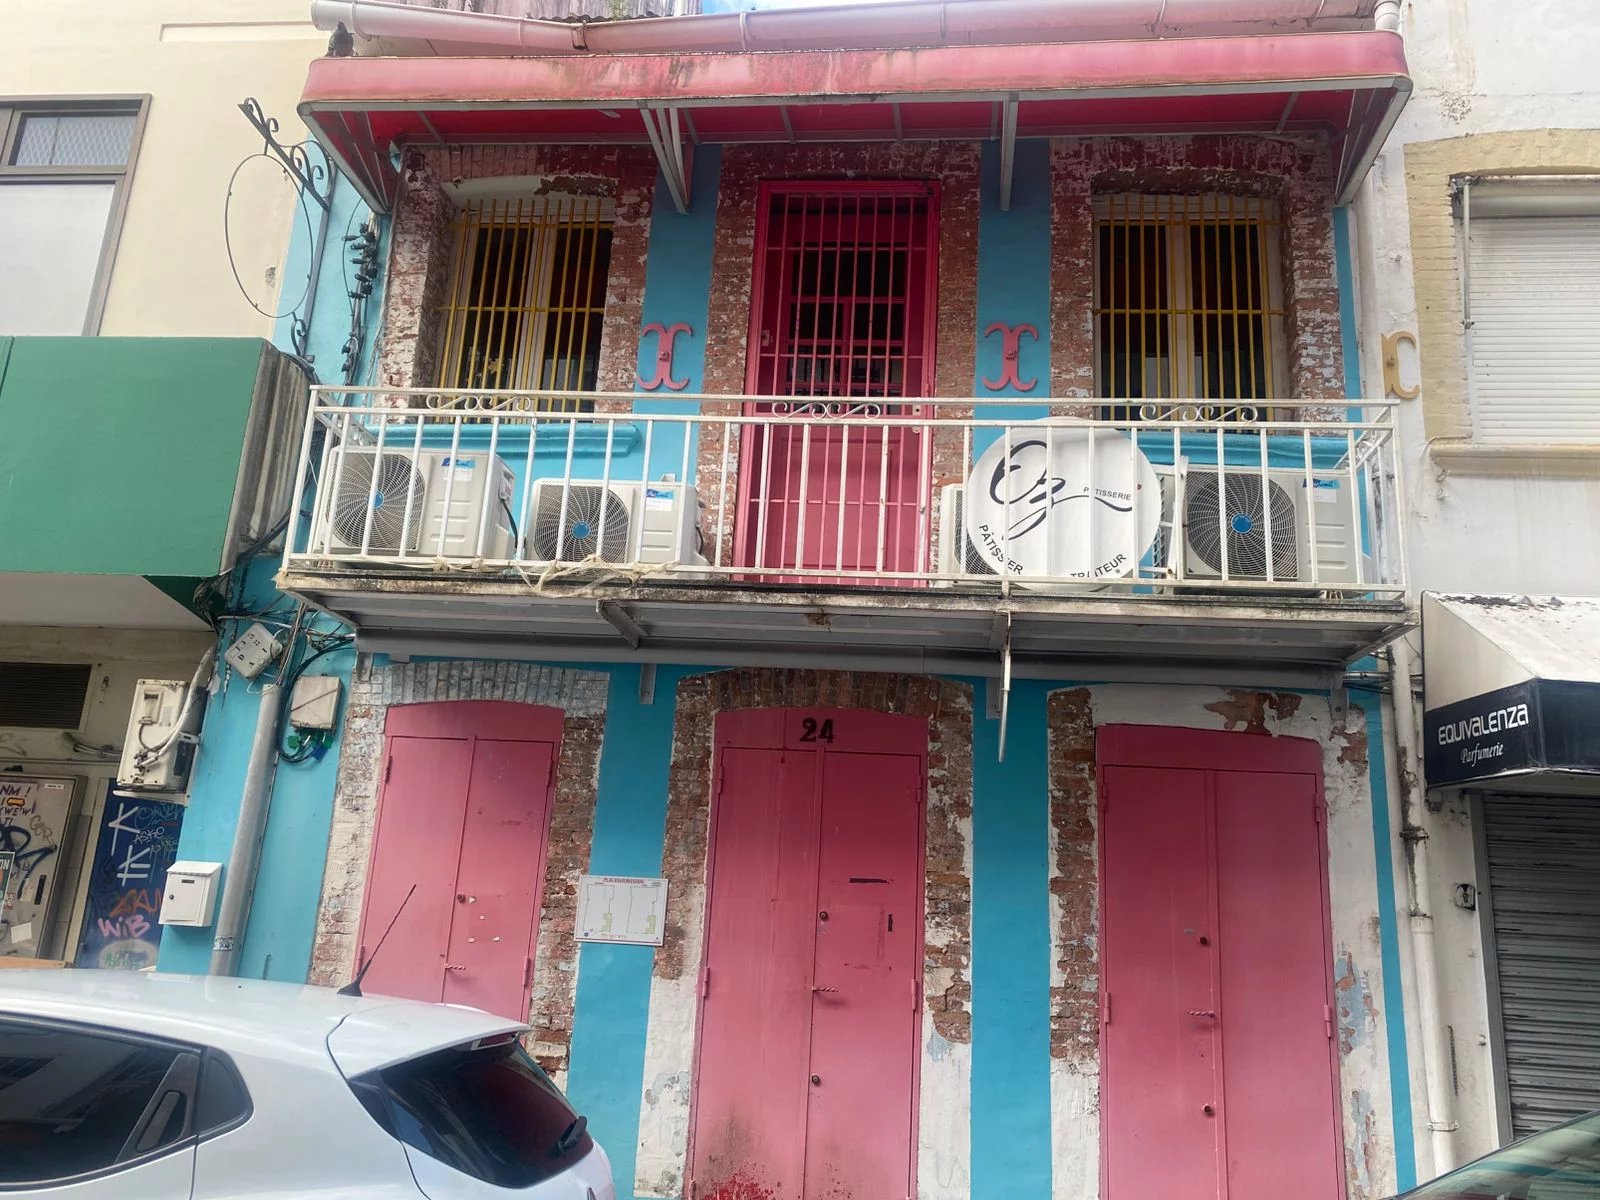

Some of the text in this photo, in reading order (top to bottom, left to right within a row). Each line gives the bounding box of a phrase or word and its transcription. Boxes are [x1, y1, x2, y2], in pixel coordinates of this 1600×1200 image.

[1083, 486, 1131, 501] PTISSERIE
[979, 524, 1024, 575] PÂTISSER
[800, 717, 834, 743] 24
[1461, 742, 1504, 767] Parfumerie
